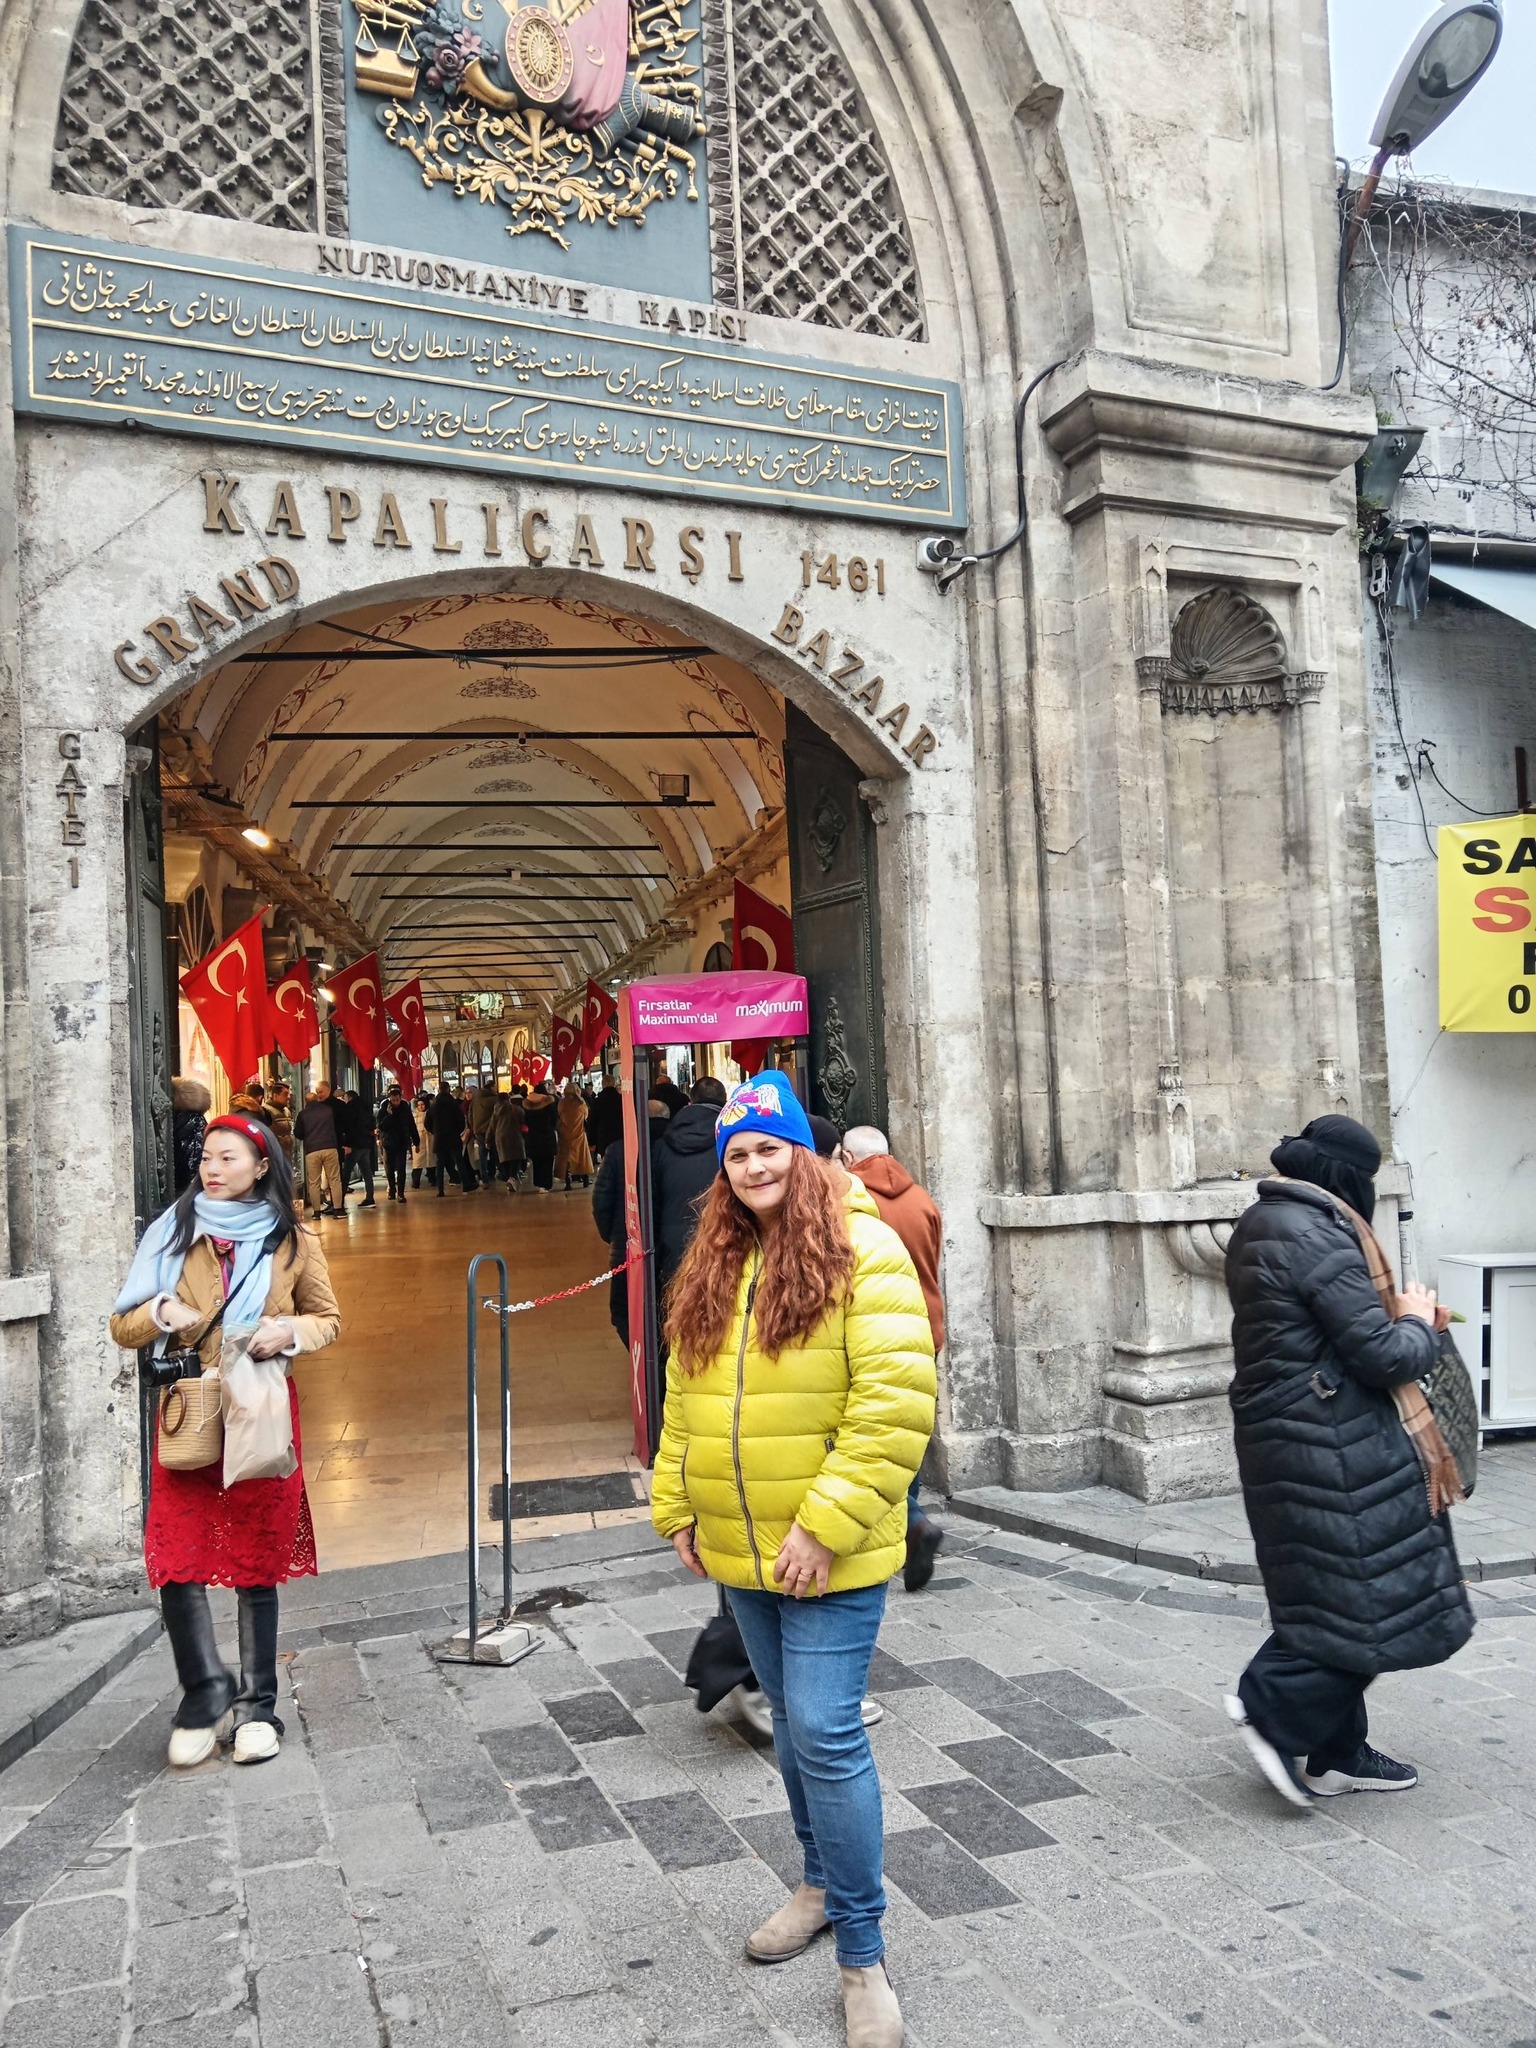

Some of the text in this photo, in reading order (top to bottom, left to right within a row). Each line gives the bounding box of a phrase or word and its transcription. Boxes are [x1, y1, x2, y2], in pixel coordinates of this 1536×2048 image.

[318, 244, 748, 342] NURUOSMANİYE KAPISI
[800, 550, 885, 595] 1461
[113, 555, 300, 685] GRAND
[770, 602, 937, 768] BAZAAR
[56, 730, 87, 889] GATE 1
[638, 999, 693, 1012] Fırsatlar
[638, 1012, 719, 1026] Maximum'da!
[735, 999, 803, 1018] maximum
